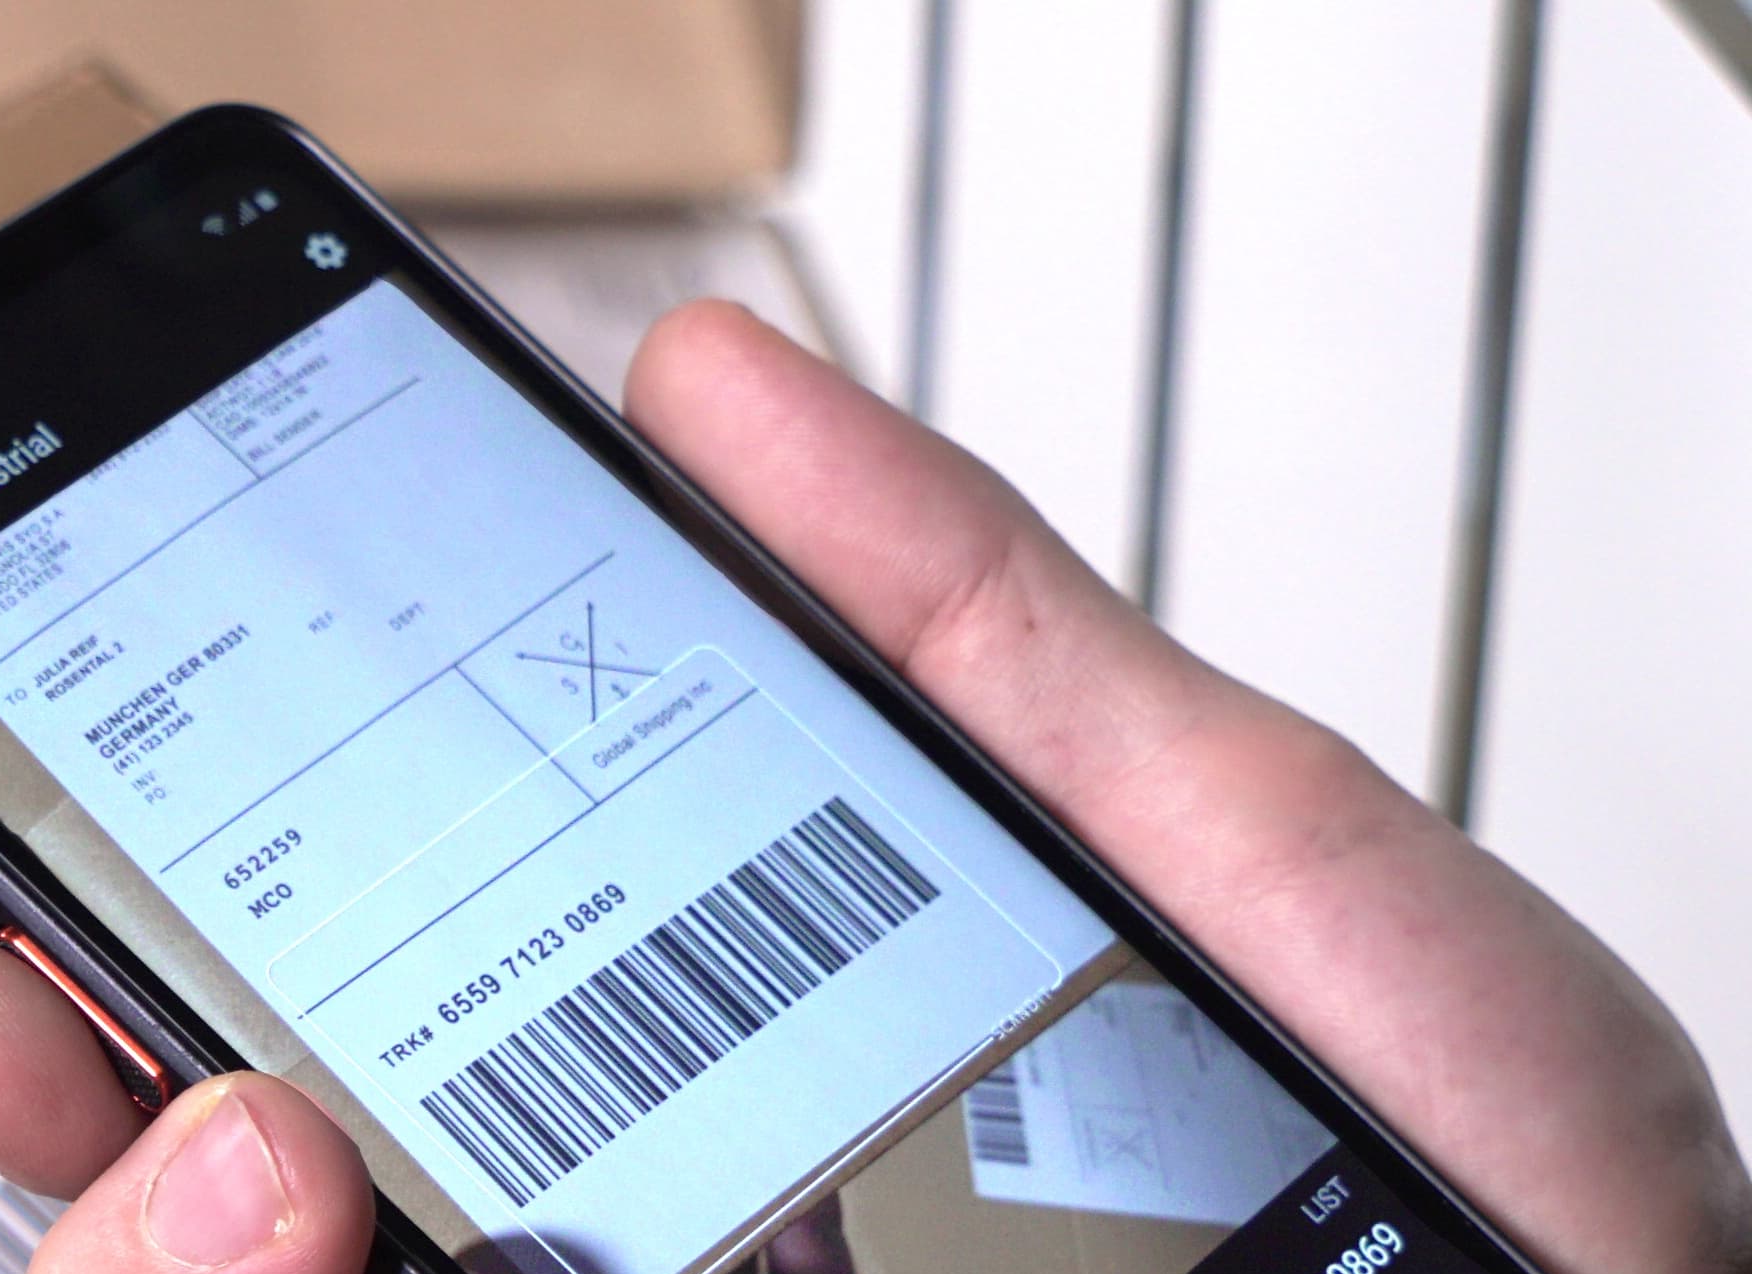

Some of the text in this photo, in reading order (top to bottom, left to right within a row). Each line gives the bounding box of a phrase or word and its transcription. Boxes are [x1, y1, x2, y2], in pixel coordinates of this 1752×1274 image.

[13, 562, 65, 600] STATES
[3, 633, 104, 707] TO JULIA REIF
[42, 648, 116, 703] ROSENTAL
[162, 654, 207, 688] GER
[199, 622, 252, 662] 80331
[95, 695, 184, 761] GERMANY
[109, 710, 196, 776] (41) 123 2345
[587, 730, 638, 771] Global
[629, 690, 697, 743] Shipping
[219, 825, 306, 892] 652259
[245, 880, 296, 920] MCO
[377, 879, 630, 1071] TRK# 6559 7123 0869
[1298, 1173, 1356, 1225] LIST
